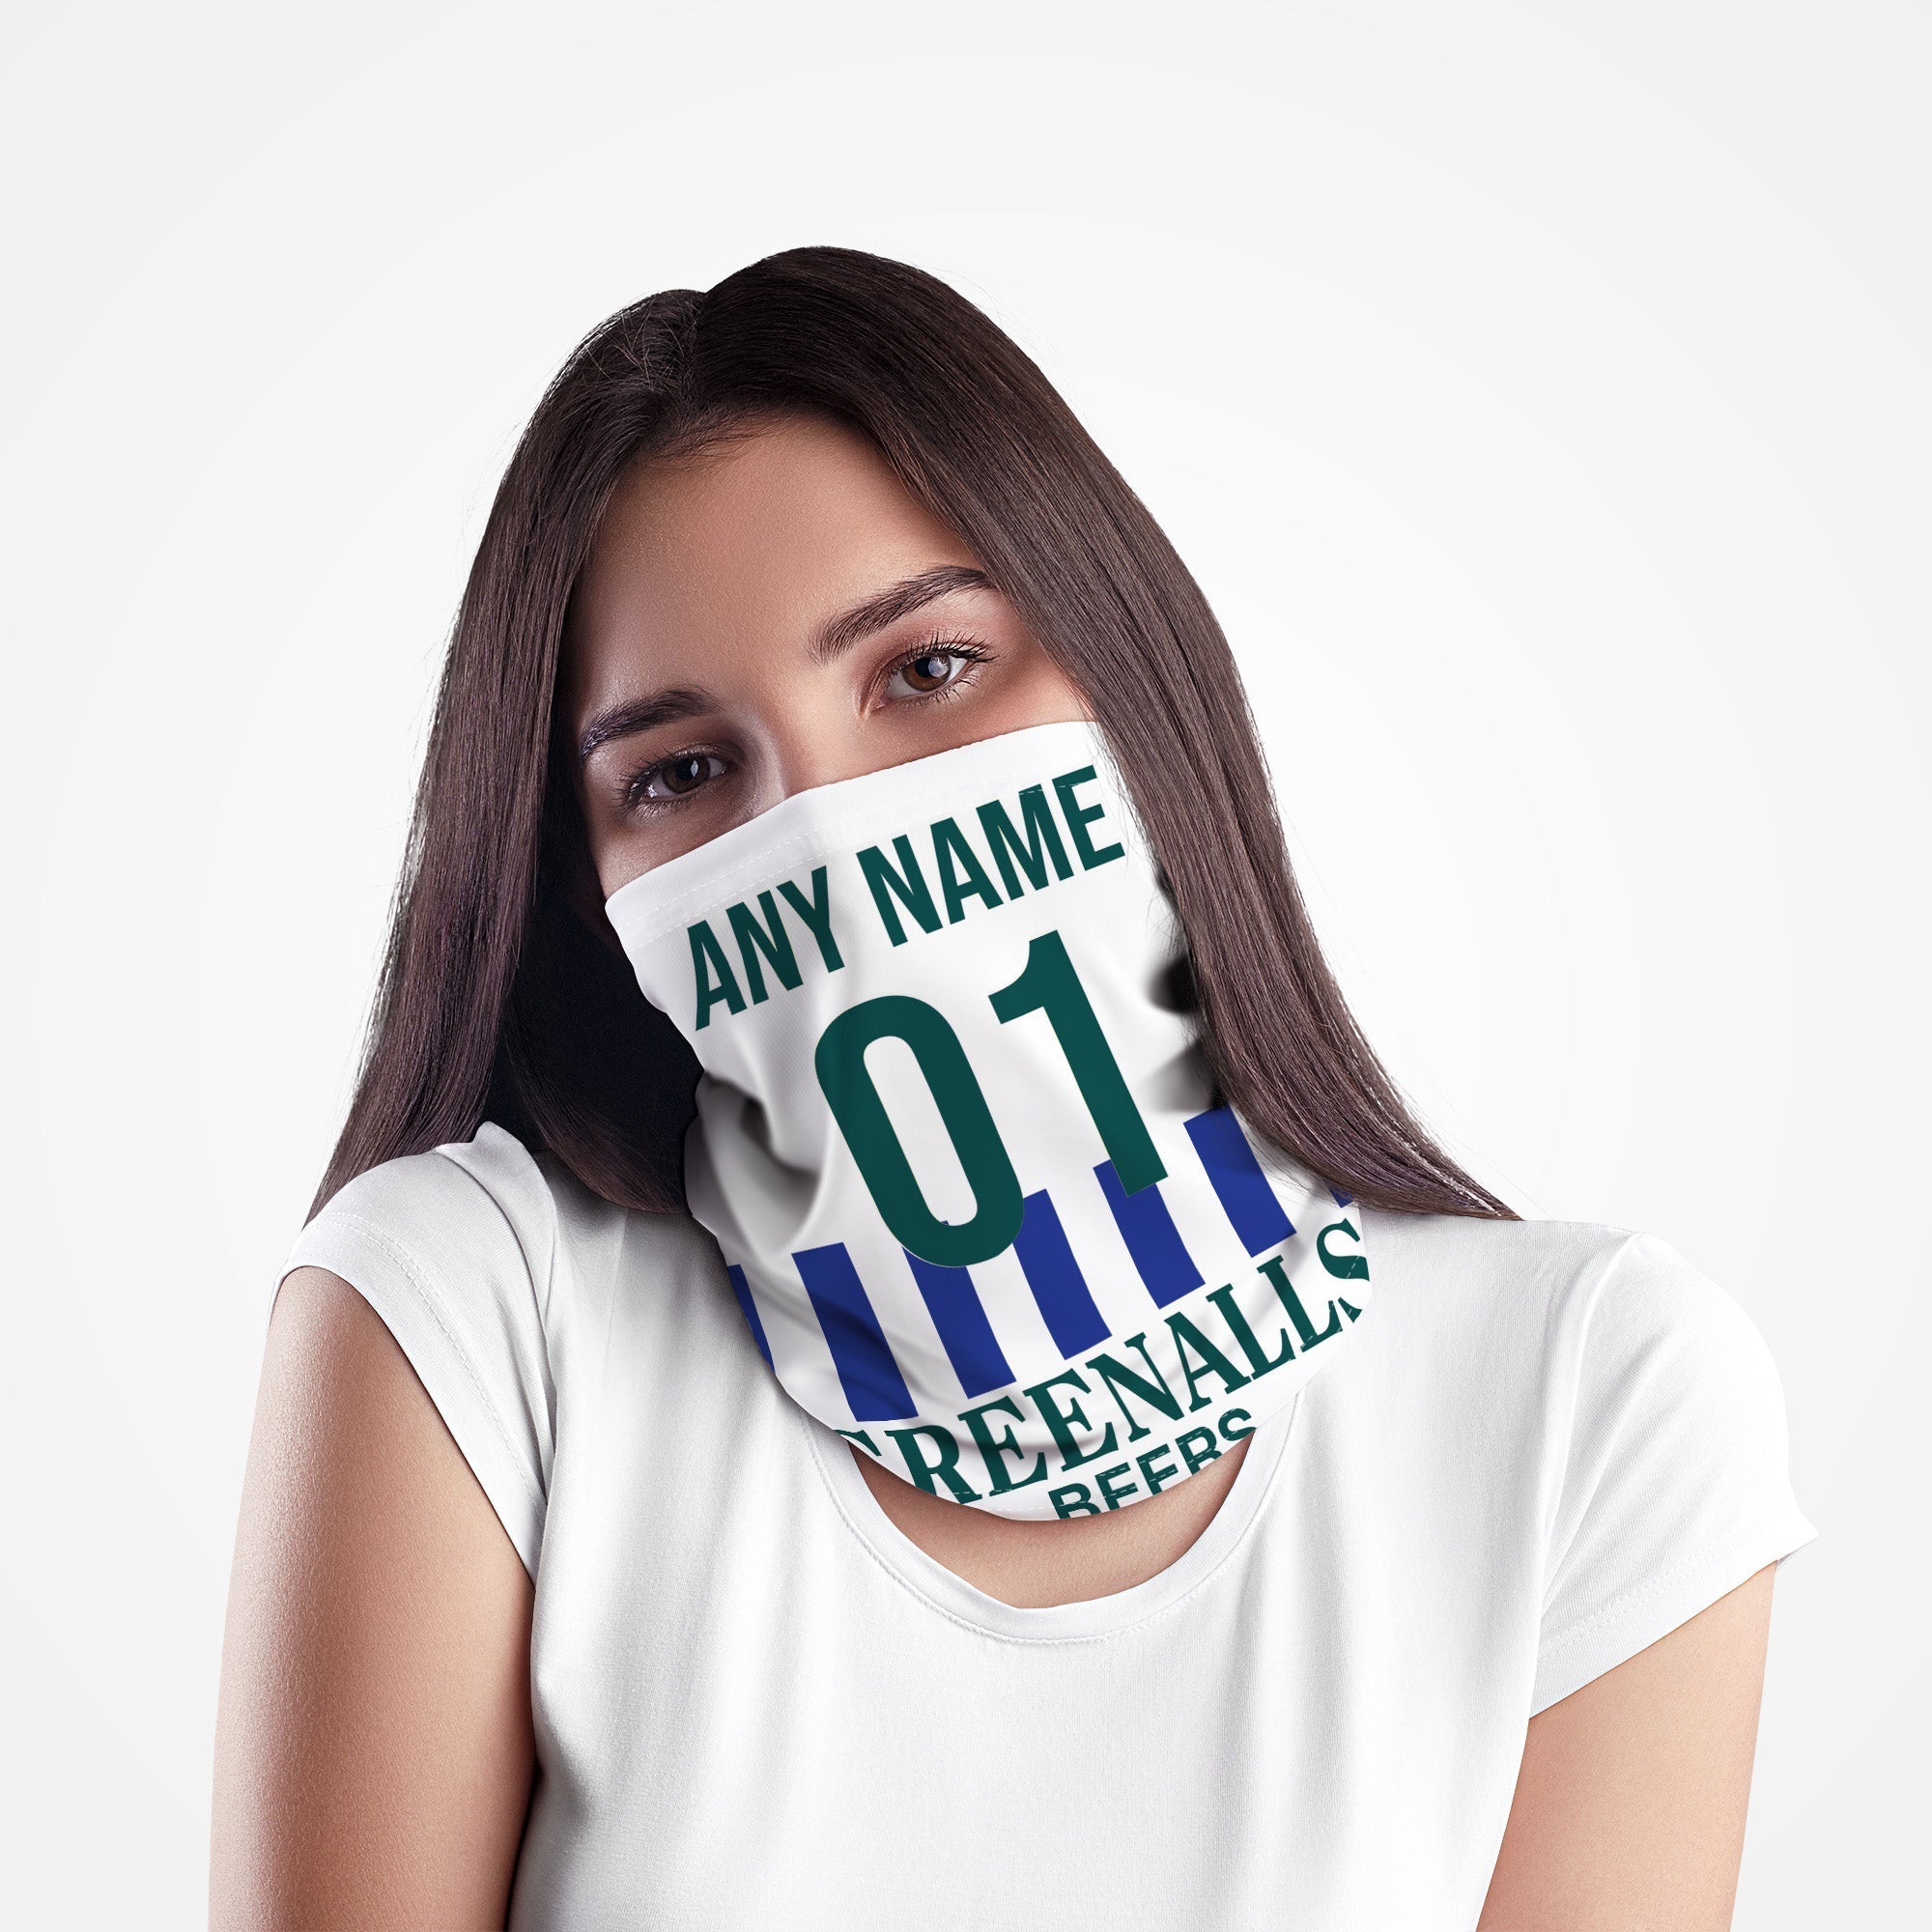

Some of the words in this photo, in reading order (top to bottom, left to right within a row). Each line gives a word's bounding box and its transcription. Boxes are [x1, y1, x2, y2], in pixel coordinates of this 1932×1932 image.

[687, 866, 845, 1031] ANY
[856, 764, 1125, 948] NAME
[814, 929, 1169, 1268] 01
